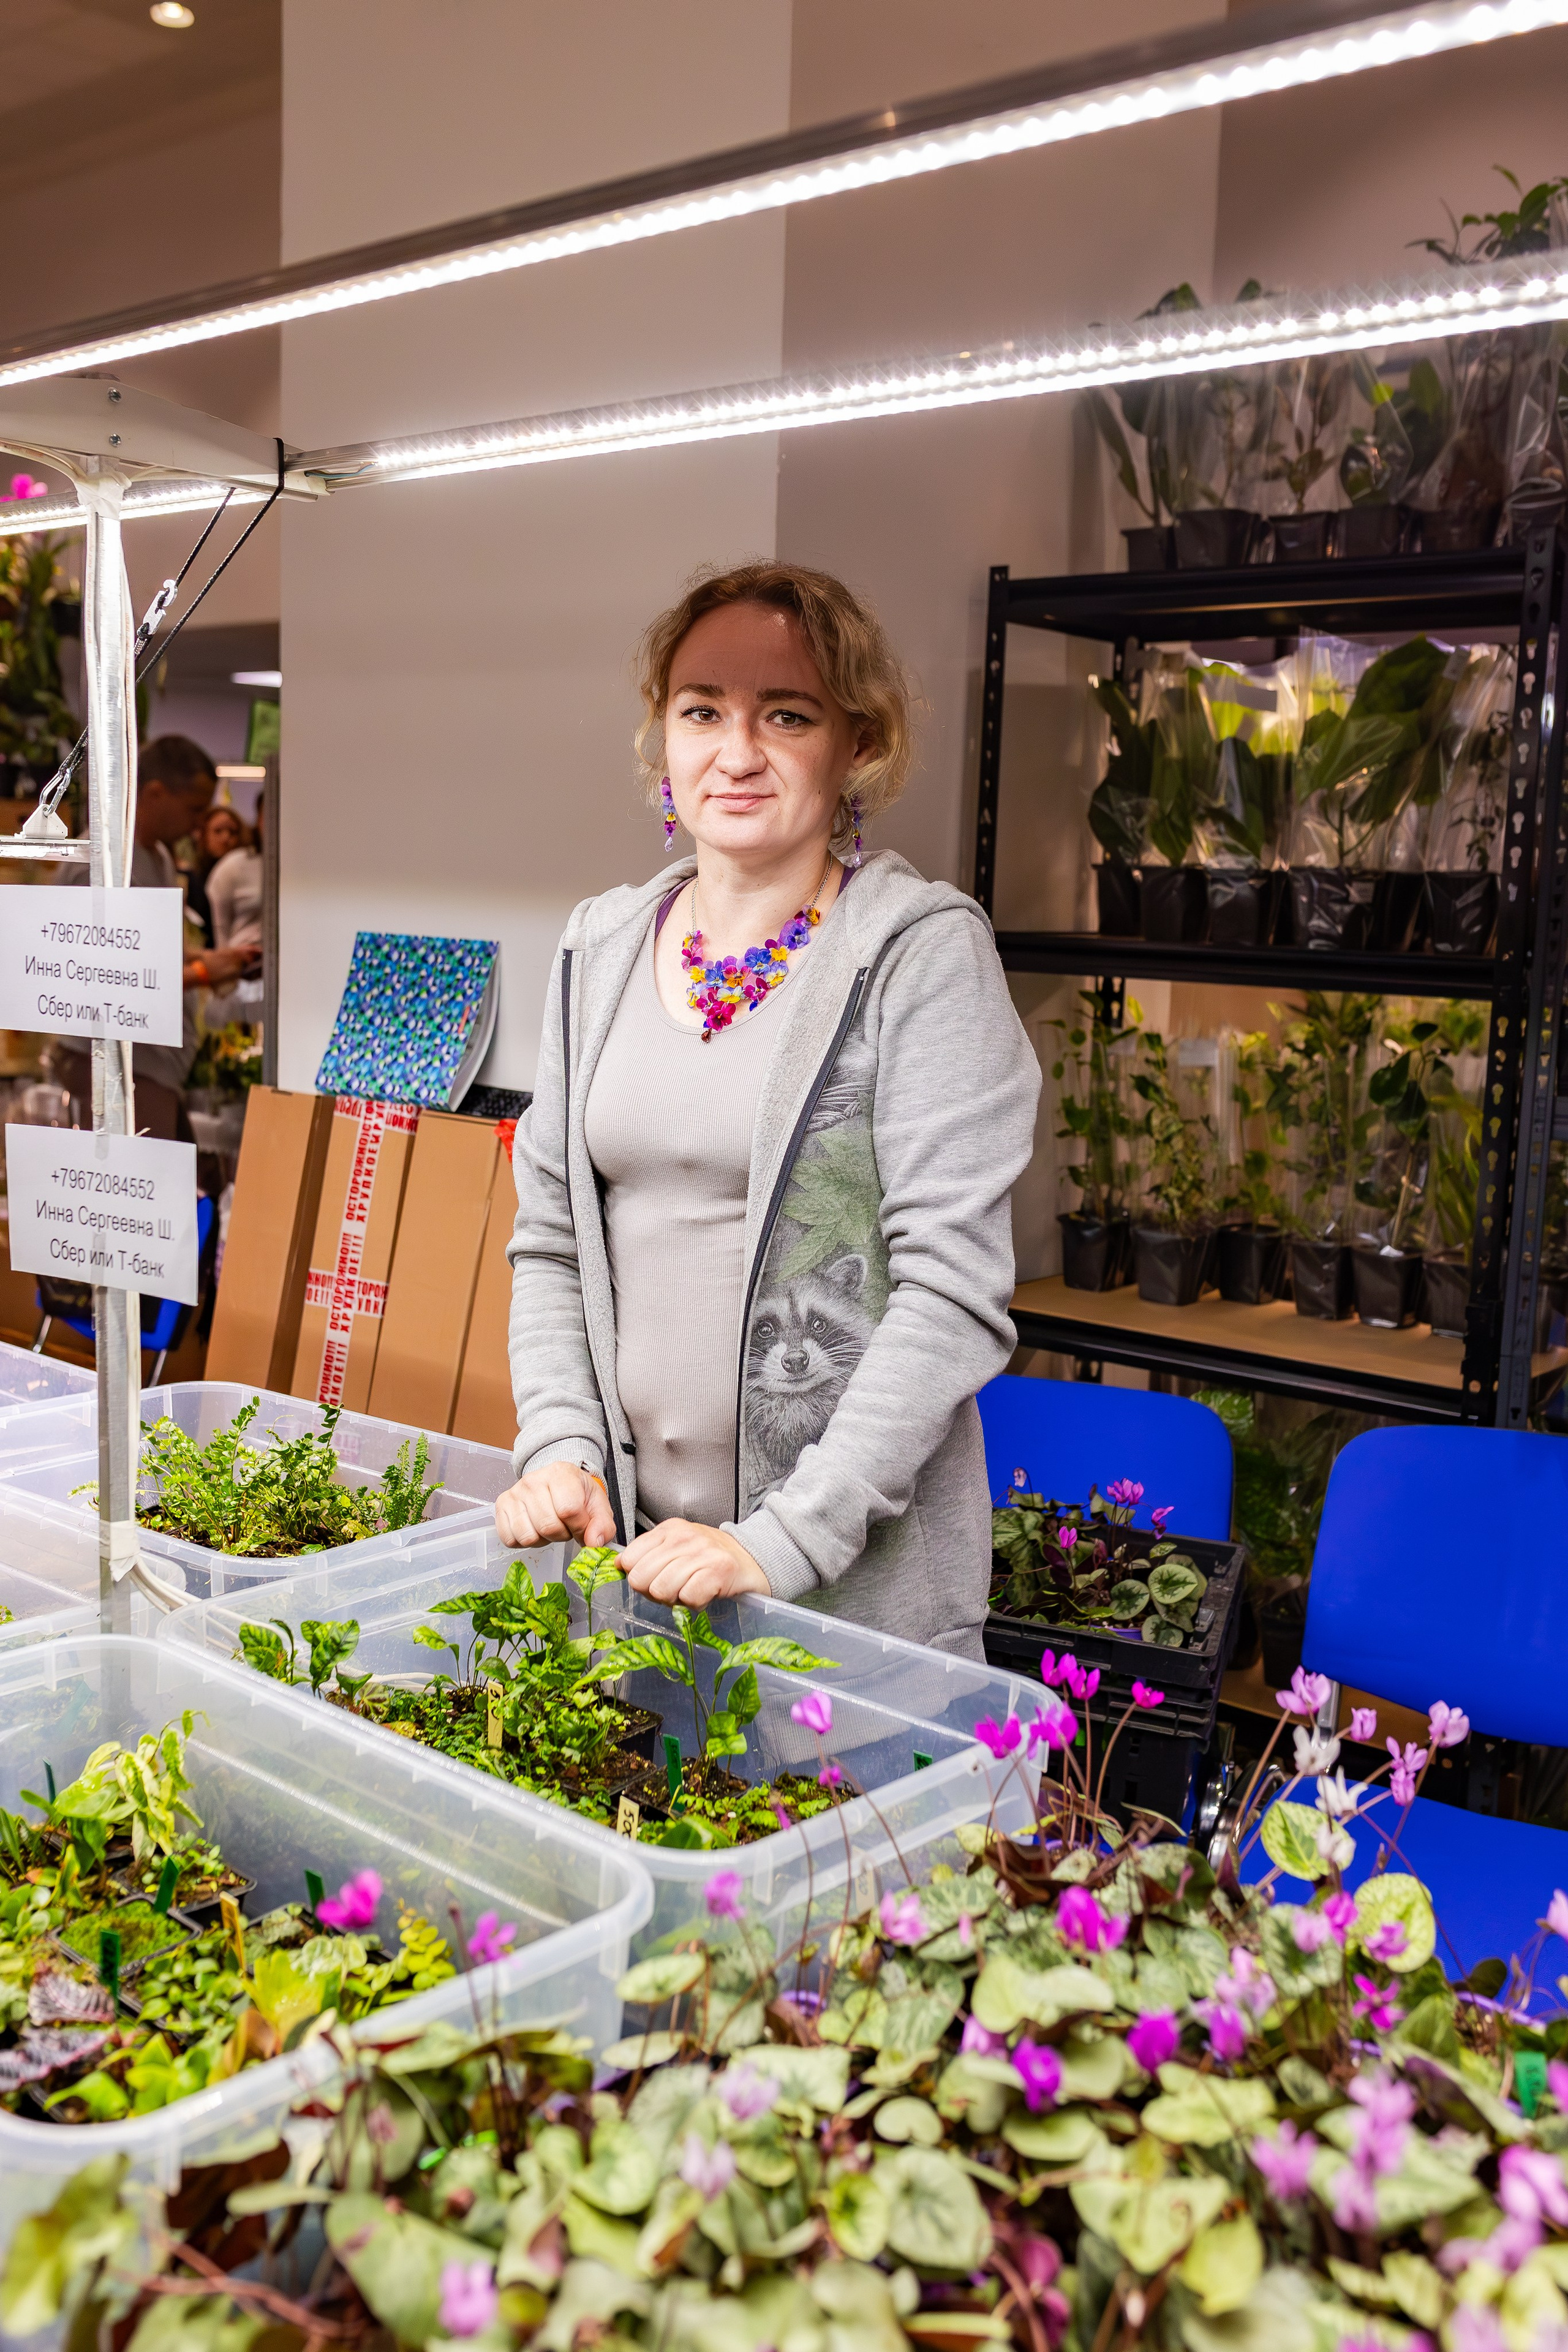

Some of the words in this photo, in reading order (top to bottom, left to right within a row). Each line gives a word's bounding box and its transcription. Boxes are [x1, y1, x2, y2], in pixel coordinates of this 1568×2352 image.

[41, 922, 140, 950] +79672084552
[25, 956, 61, 978] Инна
[66, 960, 138, 987] Сергеевна
[143, 968, 160, 990] Ш.
[38, 995, 72, 1022] Сбер
[77, 1004, 100, 1022] или
[104, 1003, 149, 1029] Т-банк
[51, 1168, 154, 1200] +79672084552
[36, 1199, 73, 1223] Инна
[78, 1206, 153, 1237] Сергеевна
[50, 1238, 85, 1267] Сбер
[90, 1250, 113, 1268] или
[118, 1250, 165, 1278] Т-банк
